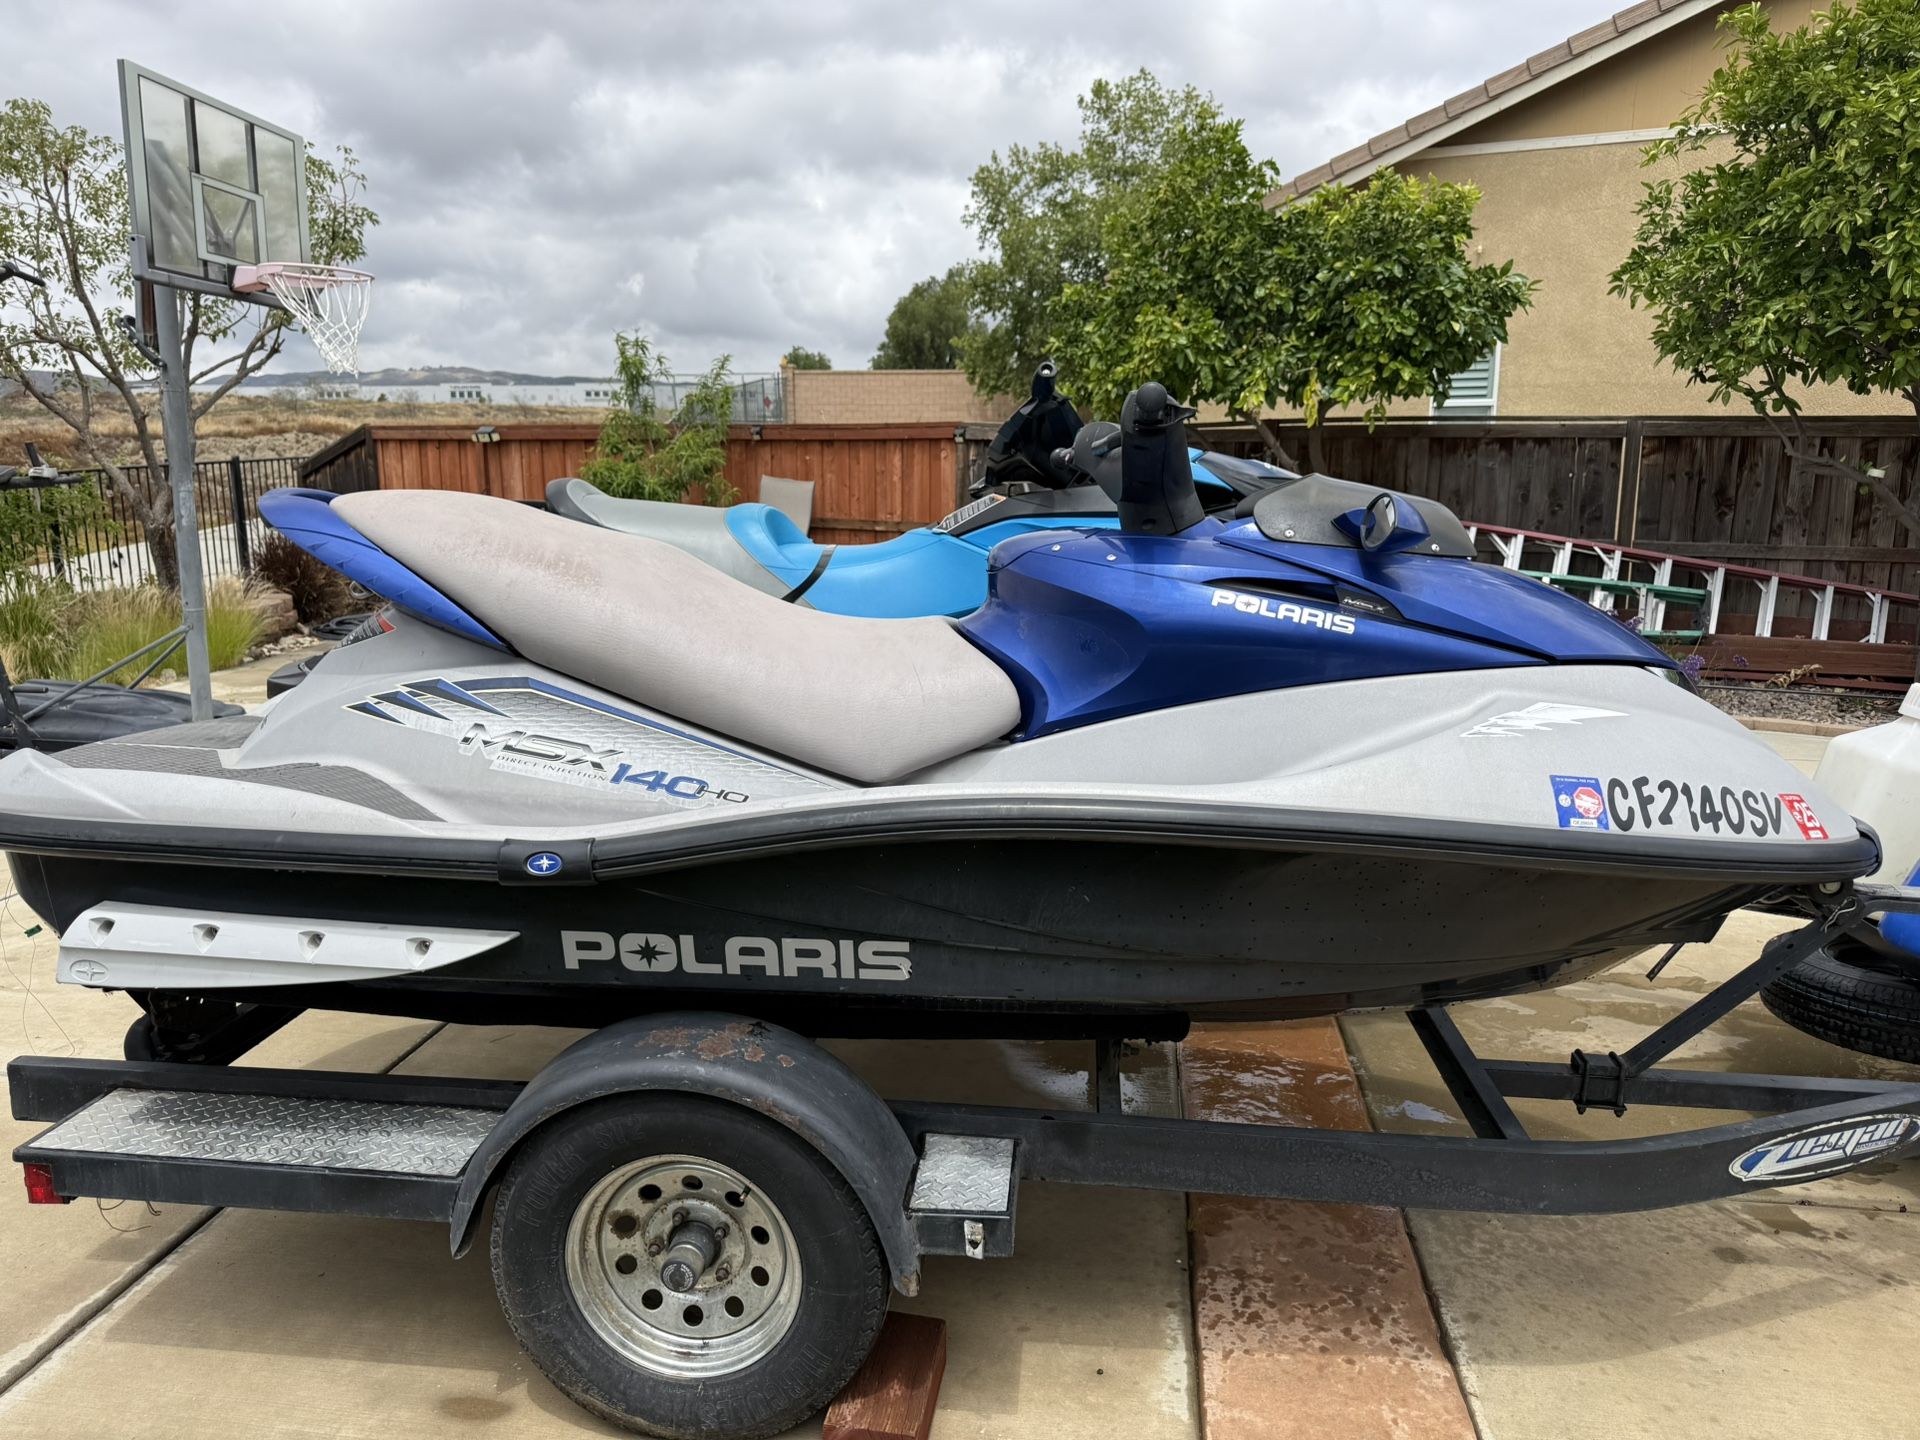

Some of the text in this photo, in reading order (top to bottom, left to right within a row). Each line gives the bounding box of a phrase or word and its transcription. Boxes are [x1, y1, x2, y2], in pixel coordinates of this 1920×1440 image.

[1211, 589, 1356, 635] POLARIS
[459, 722, 625, 772] MSX
[495, 754, 607, 782] DIRECT INJECTION
[1793, 801, 1821, 828] 25
[560, 929, 913, 981] POLARIS
[518, 1142, 585, 1228] POWER
